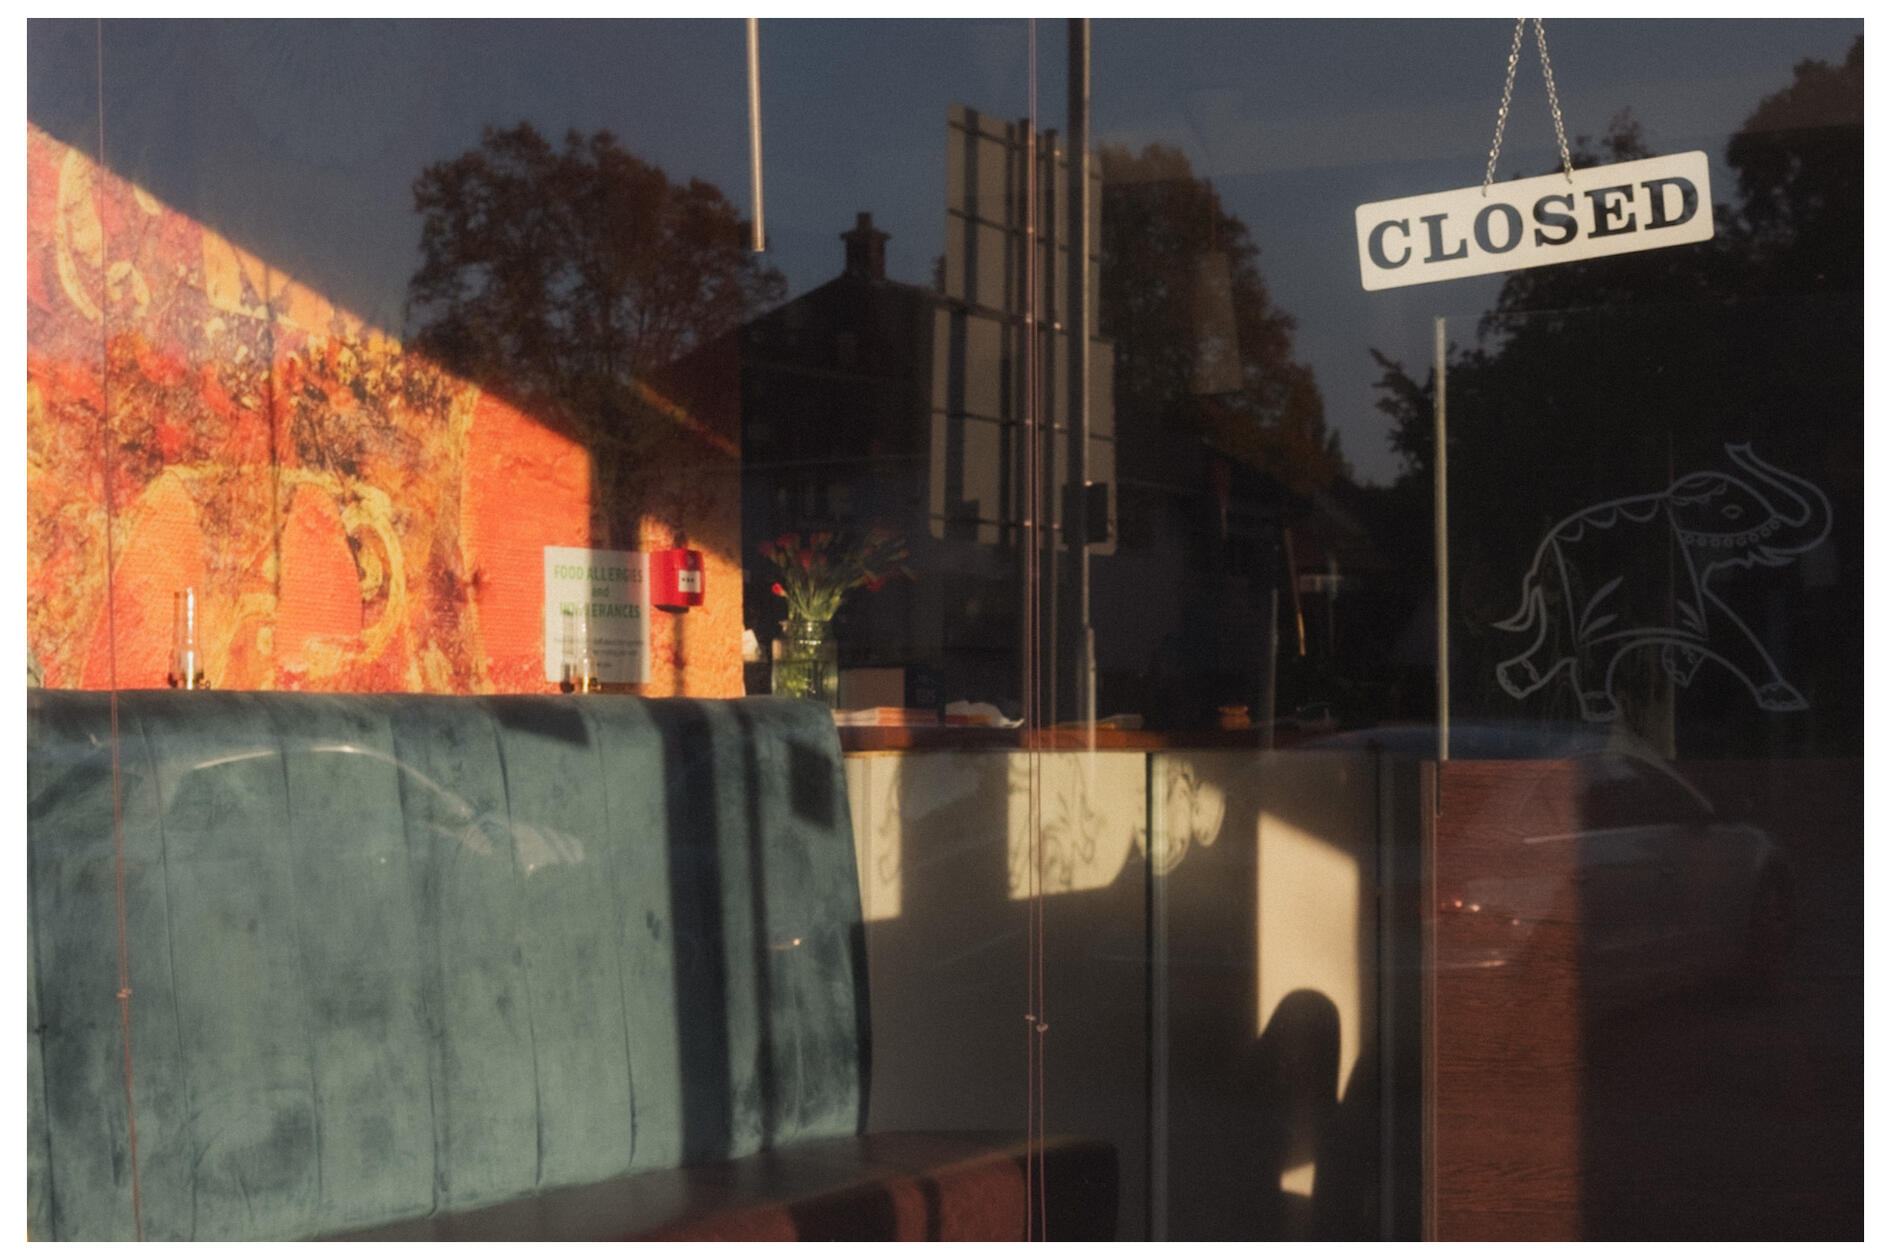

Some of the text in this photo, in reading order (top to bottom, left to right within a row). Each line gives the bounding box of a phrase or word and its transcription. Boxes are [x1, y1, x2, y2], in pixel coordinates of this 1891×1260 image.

[1367, 175, 1700, 271] CLOSED
[554, 565, 643, 583] FOOD ALLERGIES
